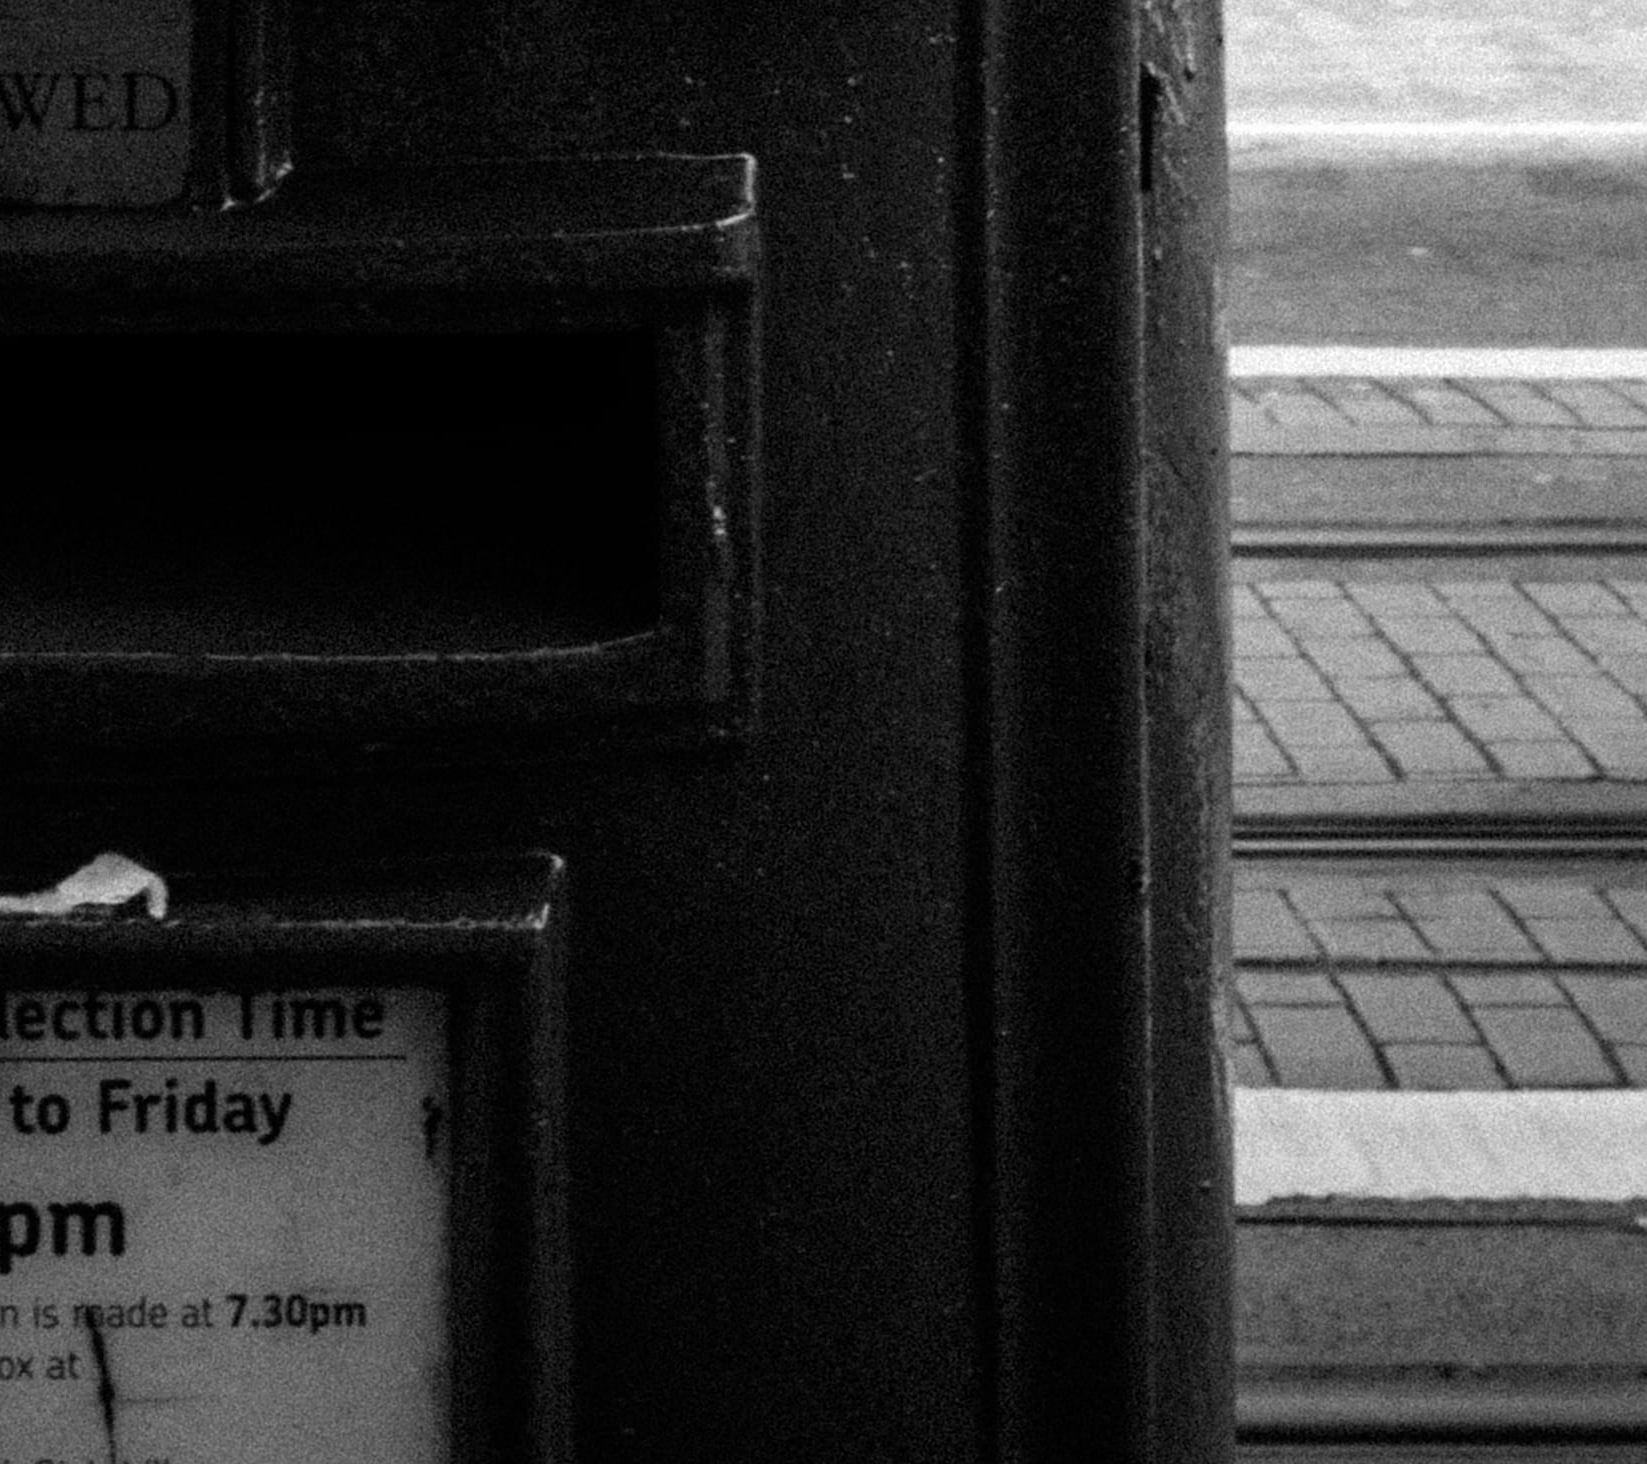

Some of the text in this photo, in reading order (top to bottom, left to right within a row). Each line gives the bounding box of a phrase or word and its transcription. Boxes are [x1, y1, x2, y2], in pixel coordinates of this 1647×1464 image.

[8, 1085, 71, 1136] to
[98, 1078, 293, 1147] Friday
[32, 1297, 60, 1331] is
[72, 1297, 168, 1331] made
[180, 1299, 214, 1330] at
[226, 1293, 368, 1335] 7.30pm
[45, 1351, 80, 1381] at
